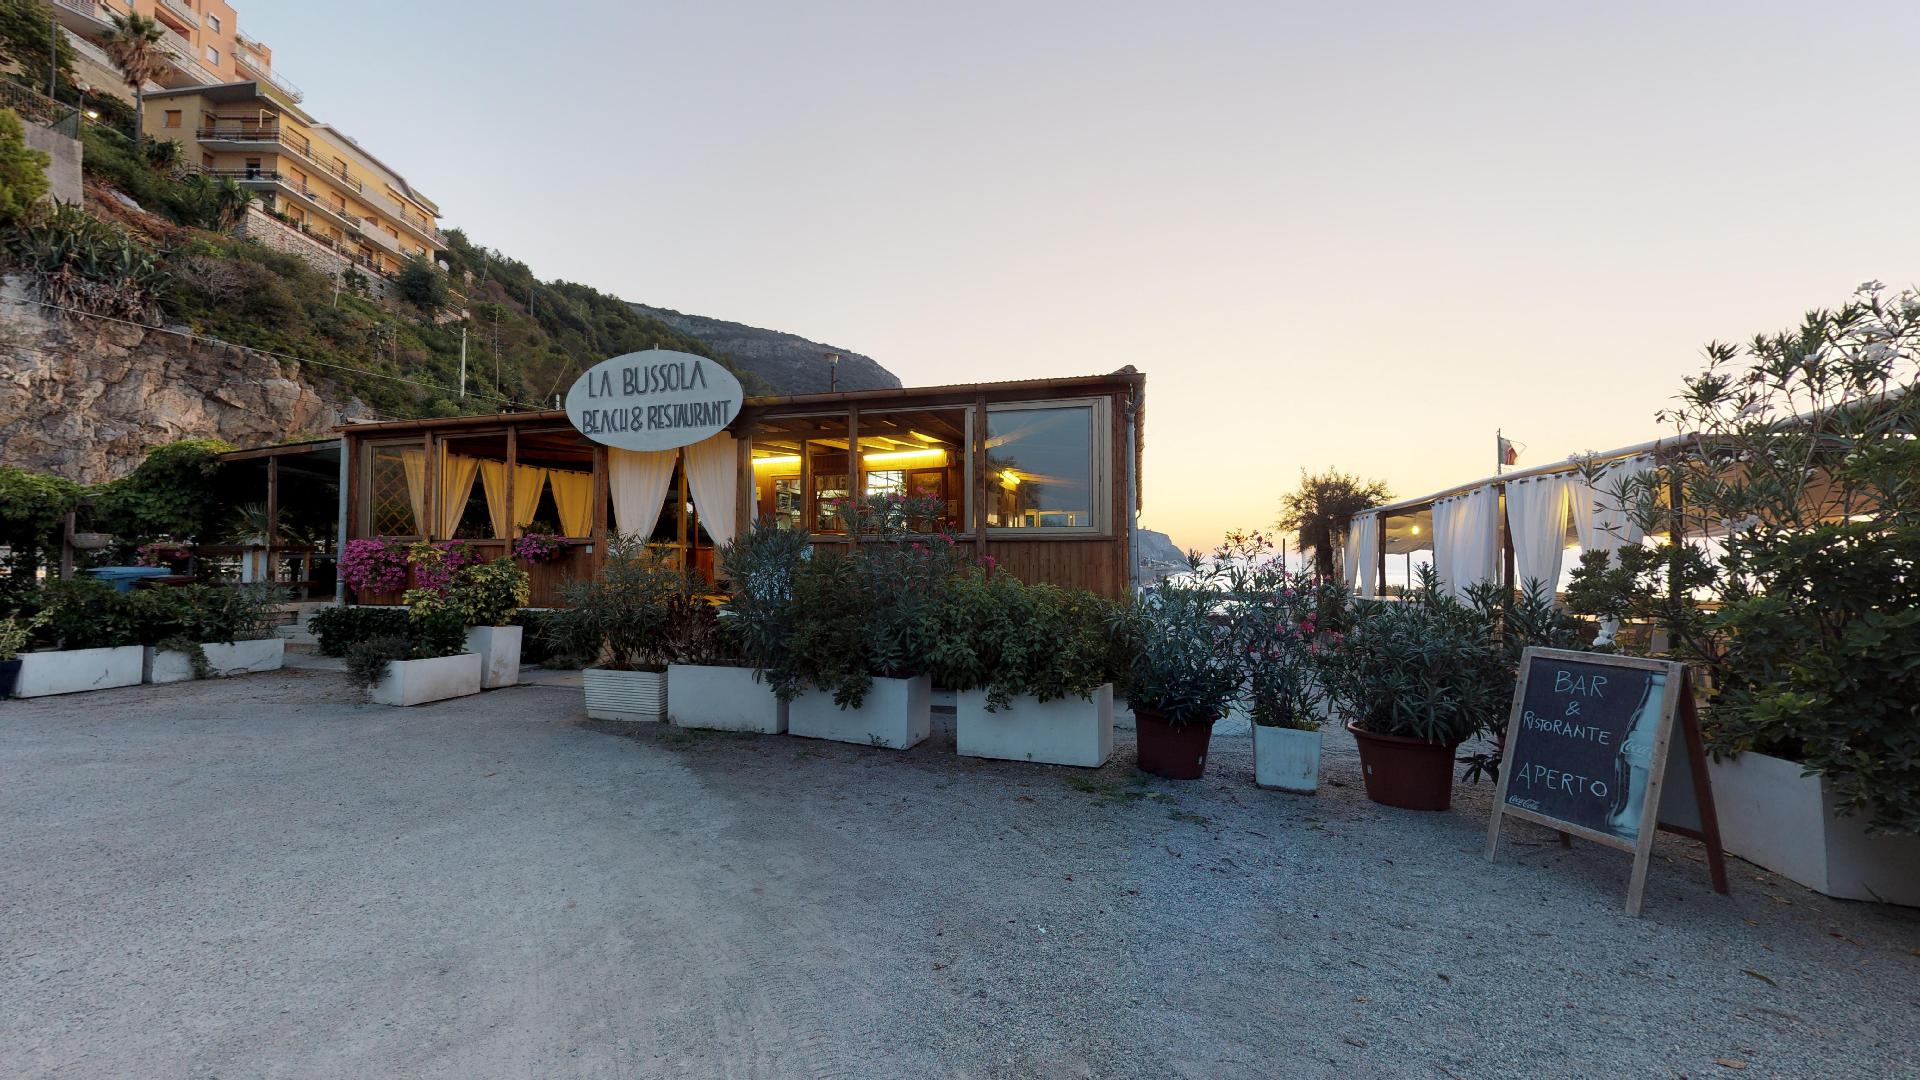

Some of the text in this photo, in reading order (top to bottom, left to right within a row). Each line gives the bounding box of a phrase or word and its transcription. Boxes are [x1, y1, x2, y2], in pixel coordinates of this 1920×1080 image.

[588, 360, 708, 398] LA BUSSOLA
[582, 400, 732, 435] BEACH & RESTAURANT
[1554, 670, 1608, 698] BAR
[1565, 700, 1581, 716] &
[1516, 762, 1608, 798] APERTO
